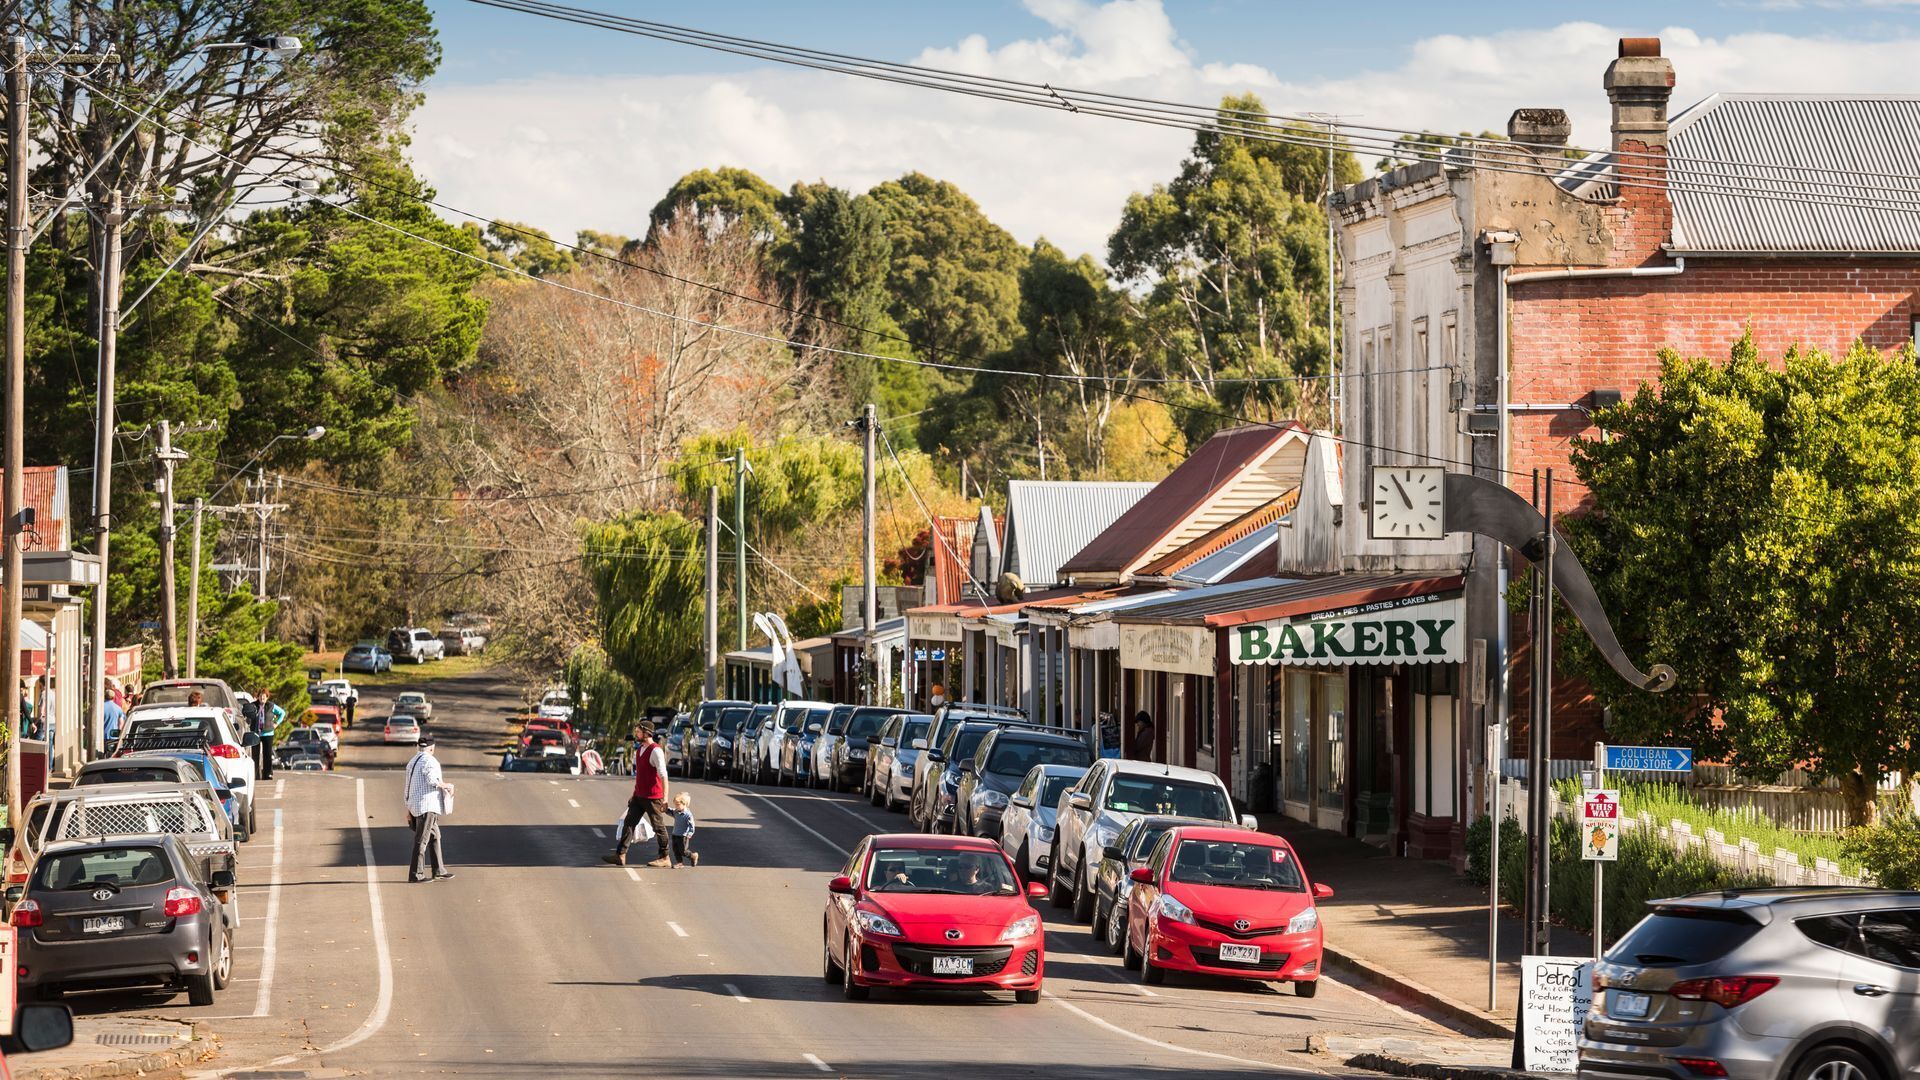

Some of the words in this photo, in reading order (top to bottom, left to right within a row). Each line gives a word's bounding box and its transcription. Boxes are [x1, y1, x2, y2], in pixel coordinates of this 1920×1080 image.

[1311, 611, 1335, 621] BREAD
[1343, 607, 1358, 616] PIES
[1366, 601, 1394, 612] PASTIES
[1401, 595, 1426, 606] CAKES
[1236, 619, 1456, 661] BAKERY
[1621, 748, 1668, 759] COLLIBAN
[1615, 757, 1640, 768] FOOD
[1643, 759, 1673, 770] STORE
[1589, 803, 1613, 811] THIS
[1592, 810, 1611, 818] WAY
[1275, 850, 1286, 861] P
[1536, 964, 1583, 988] Petrol
[1529, 989, 1564, 1001] Produce
[1568, 994, 1592, 1005] Store
[1527, 1002, 1545, 1011] 2nd
[1548, 1004, 1571, 1013] Hand
[1546, 1037, 1573, 1047] Coffee
